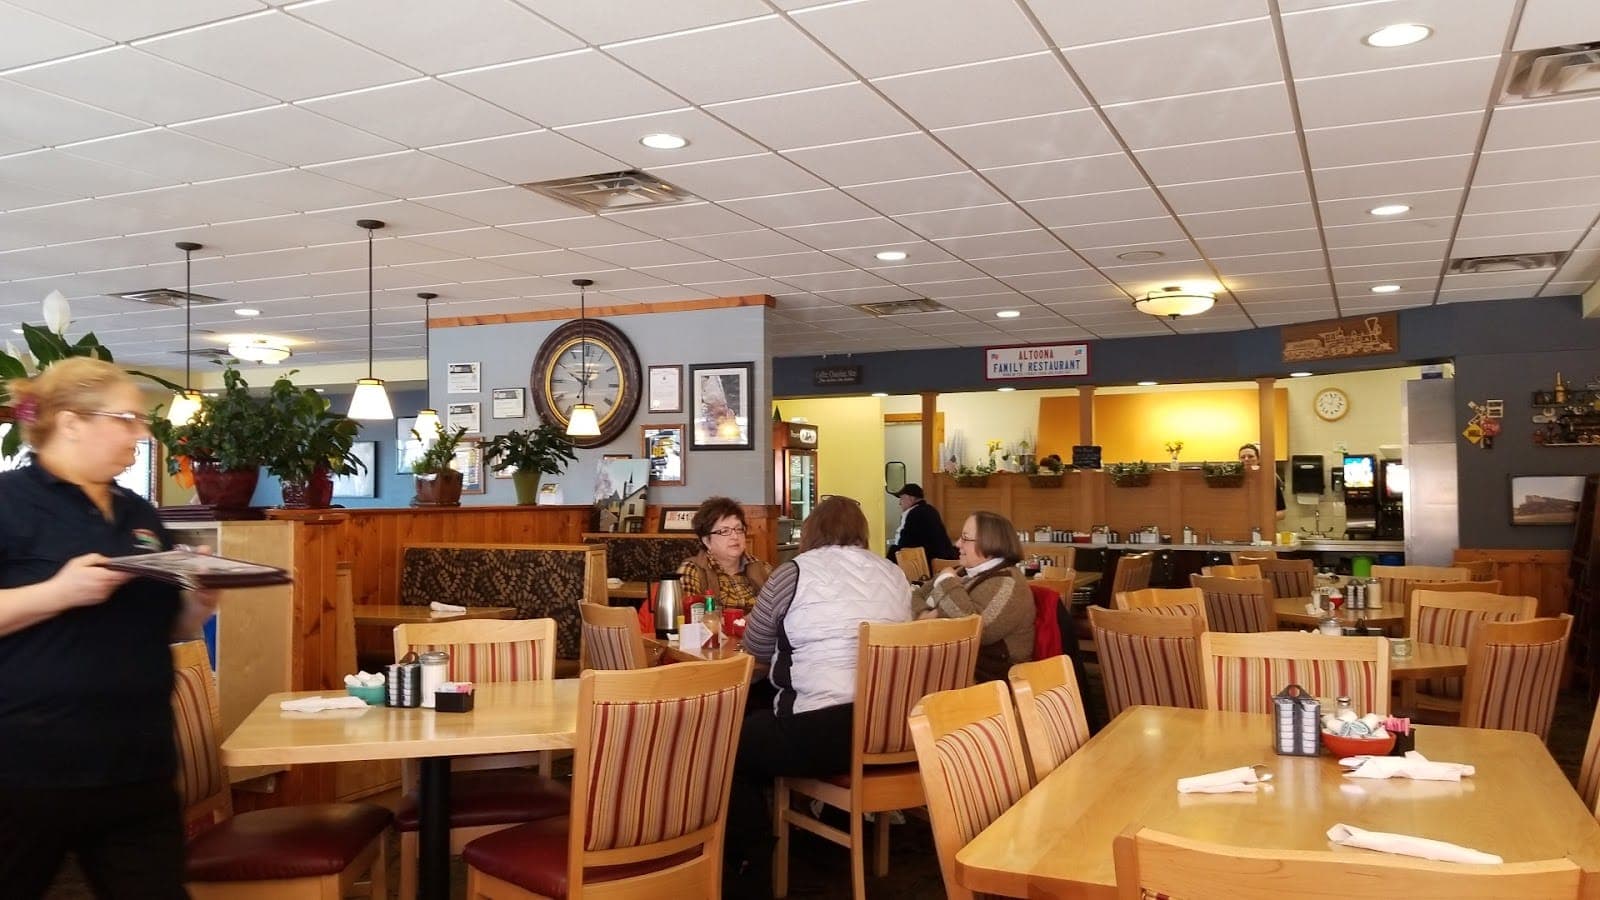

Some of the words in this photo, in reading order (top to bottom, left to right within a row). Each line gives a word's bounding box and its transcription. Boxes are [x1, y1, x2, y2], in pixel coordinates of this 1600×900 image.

[1018, 349, 1054, 360] ALTOONA
[993, 363, 1023, 373] FAMILY
[1028, 360, 1080, 371] RESTAURANT
